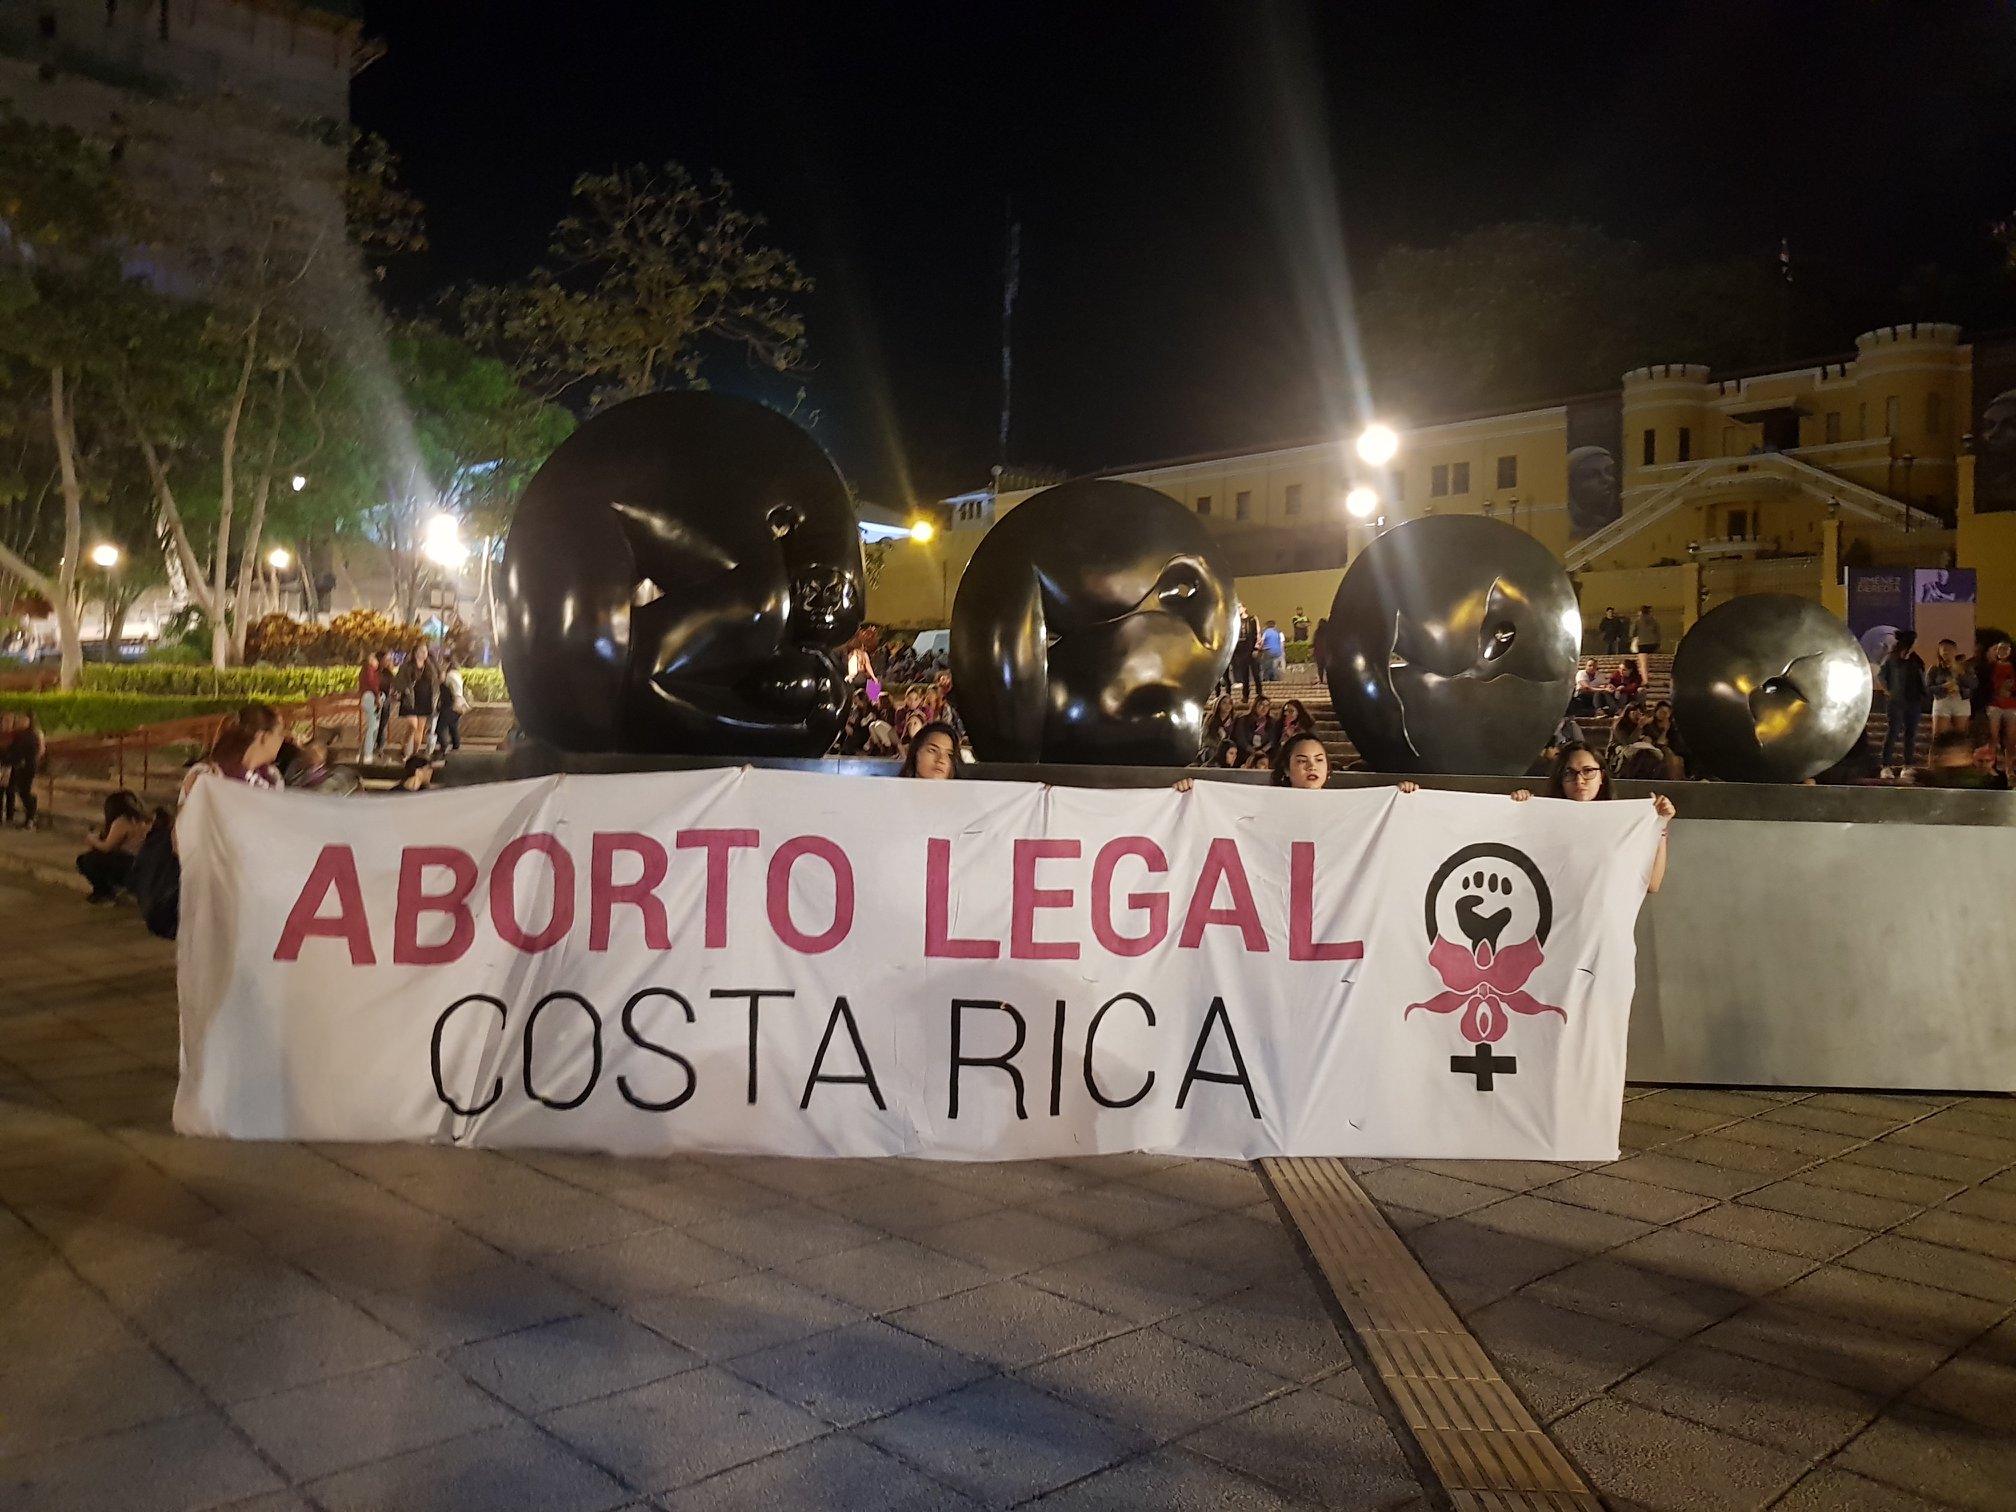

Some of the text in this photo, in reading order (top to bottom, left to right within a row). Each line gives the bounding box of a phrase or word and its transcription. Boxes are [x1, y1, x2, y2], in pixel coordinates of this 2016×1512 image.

[274, 829, 1364, 966] ABORTO LEGAL
[430, 987, 1262, 1120] COSTA RICA
